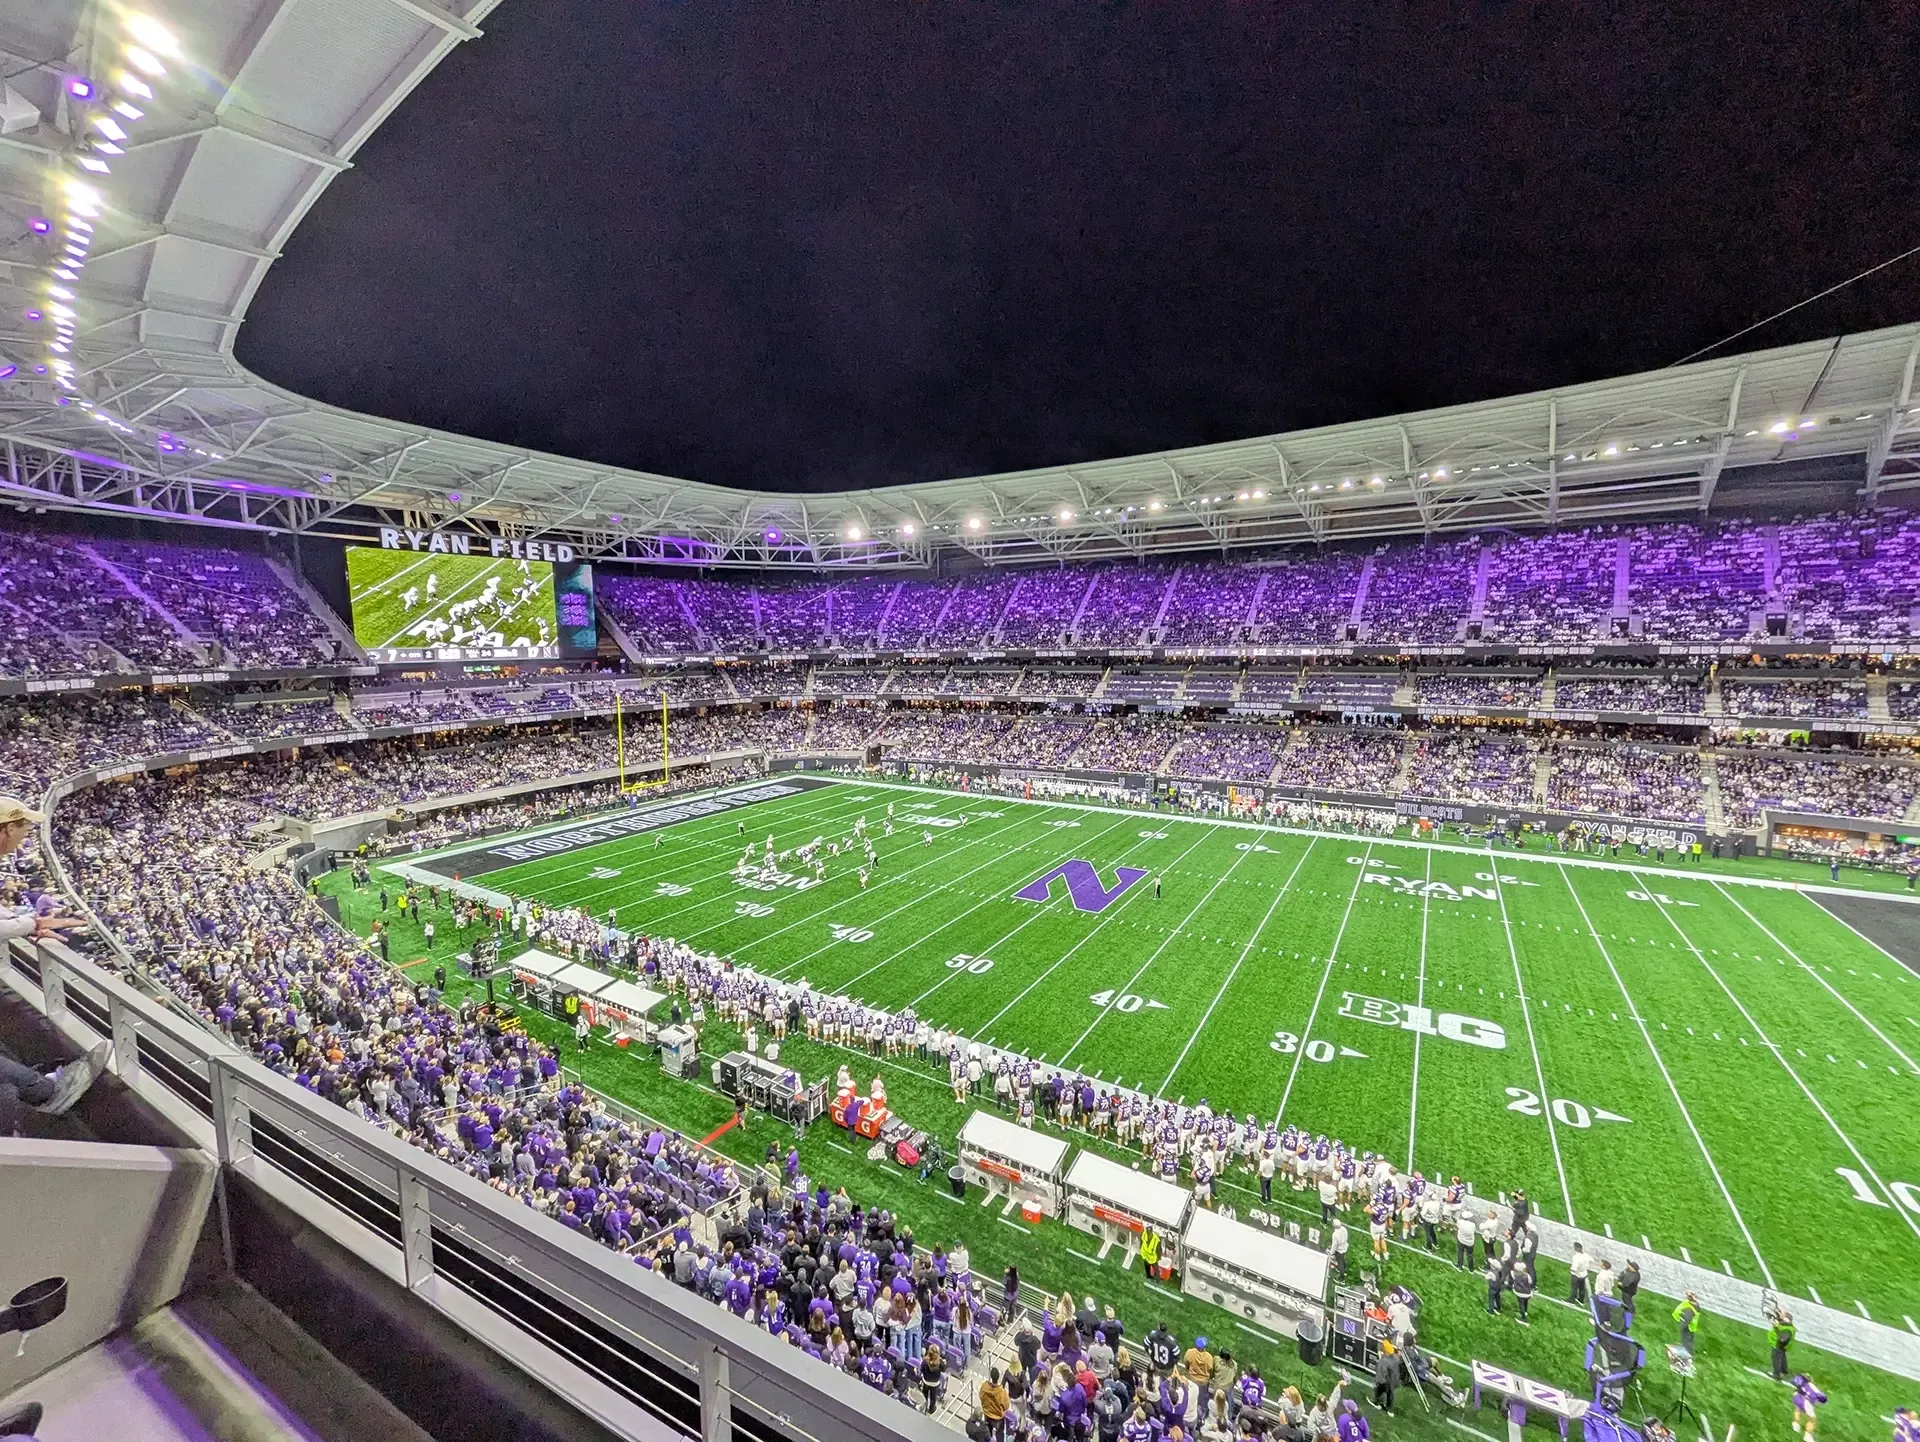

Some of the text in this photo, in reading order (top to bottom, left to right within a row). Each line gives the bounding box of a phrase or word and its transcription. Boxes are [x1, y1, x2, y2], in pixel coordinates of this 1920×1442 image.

[380, 528, 574, 563] RYAN FIELD
[388, 649, 397, 661] 7
[1170, 781, 1203, 791] RYAN
[1395, 801, 1463, 820] WILDCATS
[487, 784, 803, 861] NORTHWESTERN
[1346, 856, 1386, 868] 30
[1011, 858, 1150, 914] N
[1475, 872, 1518, 885] 20
[1363, 873, 1498, 901] RYAN
[1394, 887, 1463, 902] FIELD
[735, 903, 775, 917] 30
[945, 953, 995, 974] 50
[1089, 989, 1144, 1013] 40
[1270, 1032, 1336, 1063] 30
[1505, 1087, 1593, 1128] 20
[835, 1110, 844, 1122] G
[861, 1121, 870, 1133] G
[1286, 1138, 1296, 1148] 78
[796, 1181, 807, 1194] 98
[860, 1261, 871, 1272] 34
[1343, 1318, 1356, 1335] N
[1153, 1343, 1169, 1365] 13
